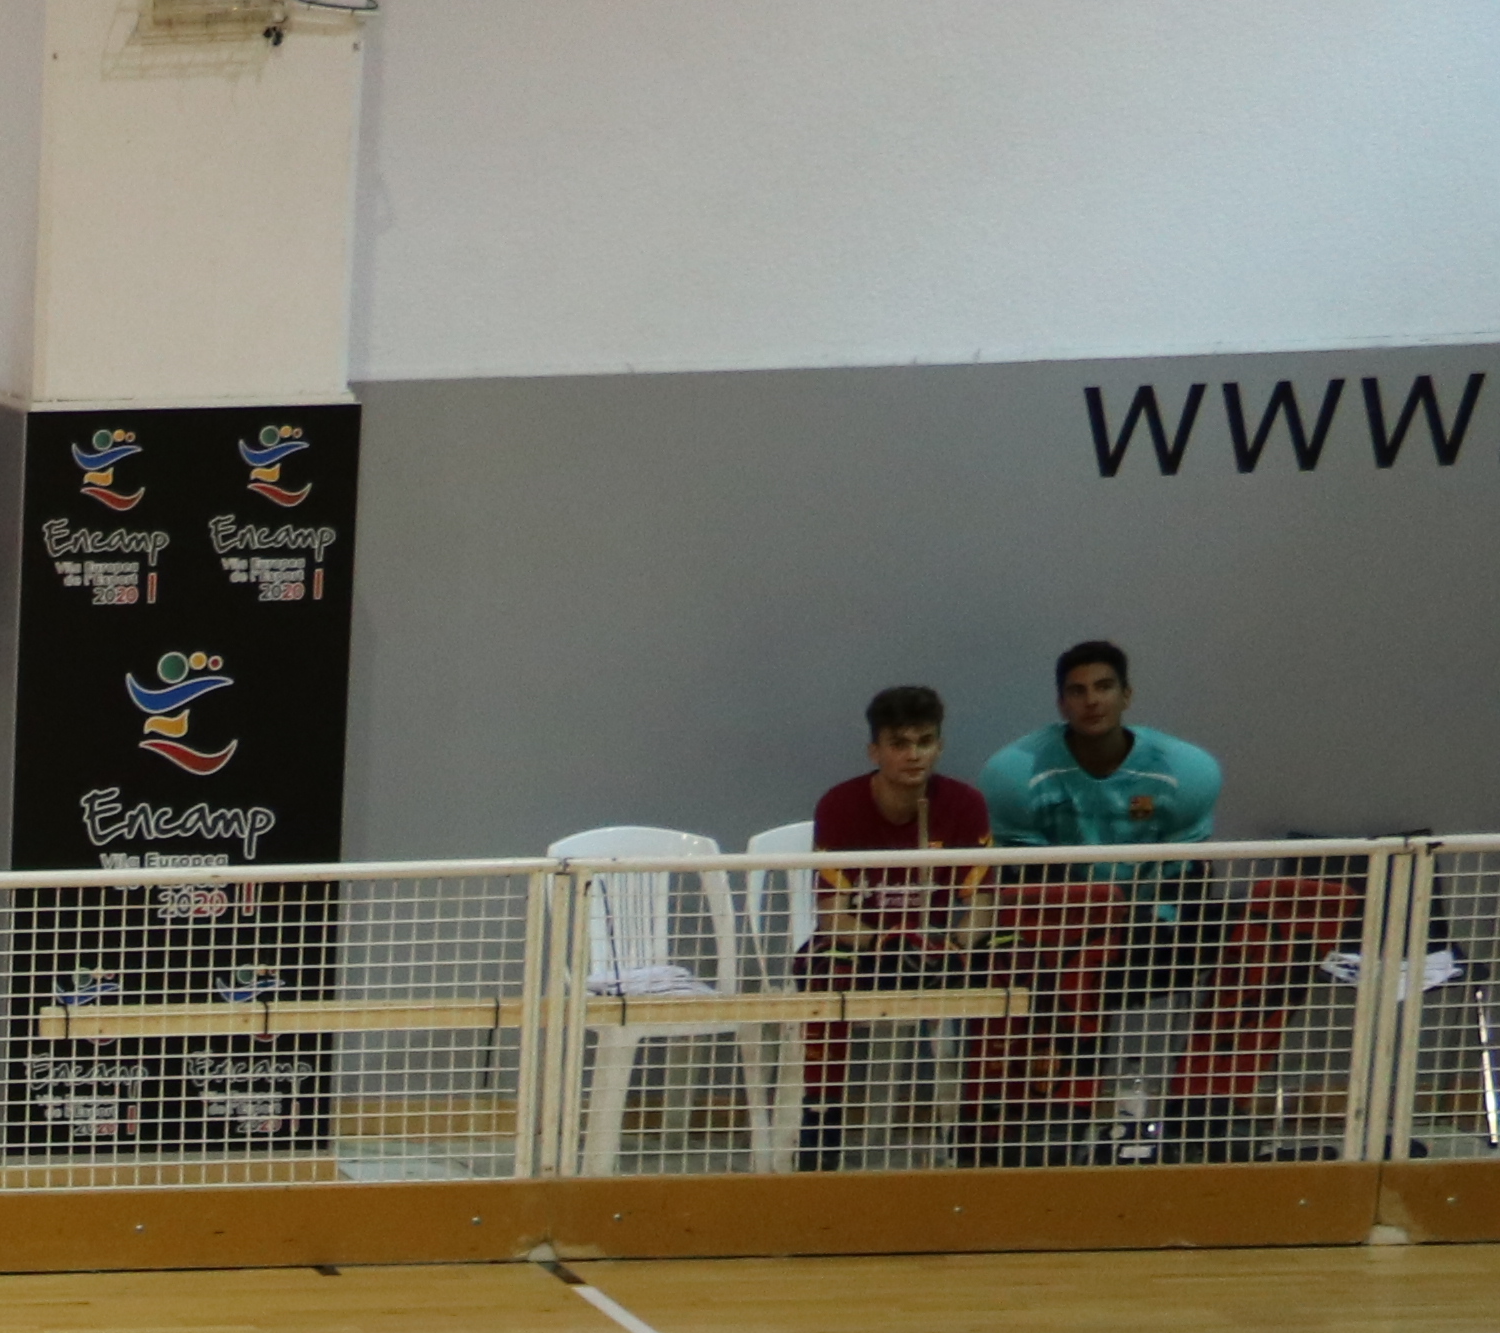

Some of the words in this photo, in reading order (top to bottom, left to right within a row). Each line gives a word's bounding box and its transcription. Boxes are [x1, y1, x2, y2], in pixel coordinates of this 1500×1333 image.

[1083, 372, 1486, 478] www
[42, 518, 170, 567] Encamp
[208, 514, 337, 563] Encamp
[91, 585, 140, 605] 2020
[258, 582, 306, 602] 2020
[80, 786, 276, 860] Encamp
[156, 888, 229, 918] 2020
